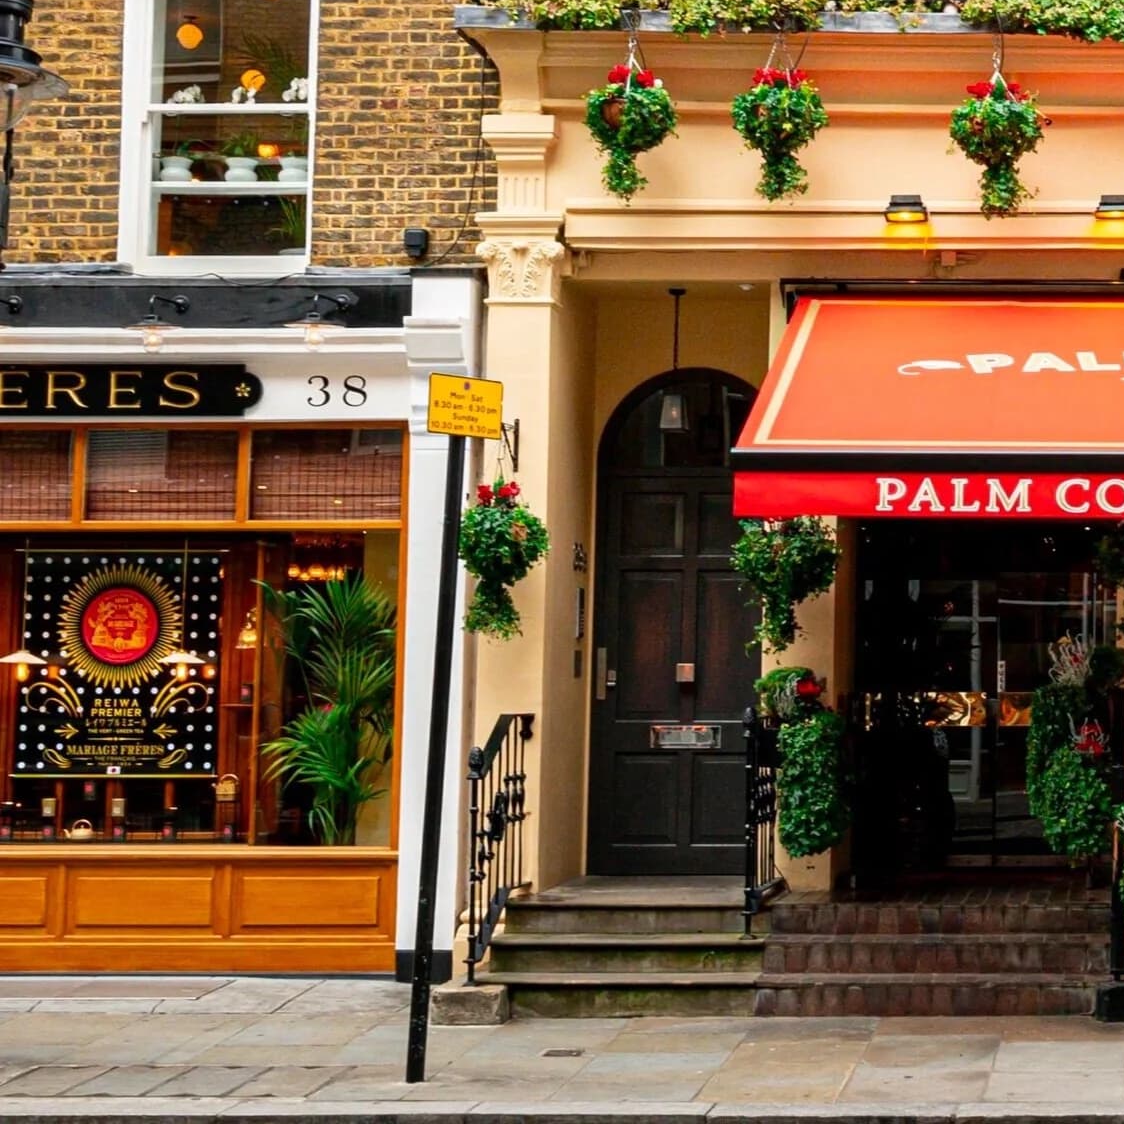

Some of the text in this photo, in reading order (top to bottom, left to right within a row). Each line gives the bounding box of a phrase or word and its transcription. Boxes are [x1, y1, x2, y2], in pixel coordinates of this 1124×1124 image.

[307, 375, 368, 407] 38
[471, 394, 484, 403] Sat
[452, 412, 479, 423] Sunday
[875, 477, 1033, 513] PALM
[94, 698, 139, 708] REIWA
[91, 708, 142, 717] PREMIER
[66, 744, 119, 756] MARIAGE
